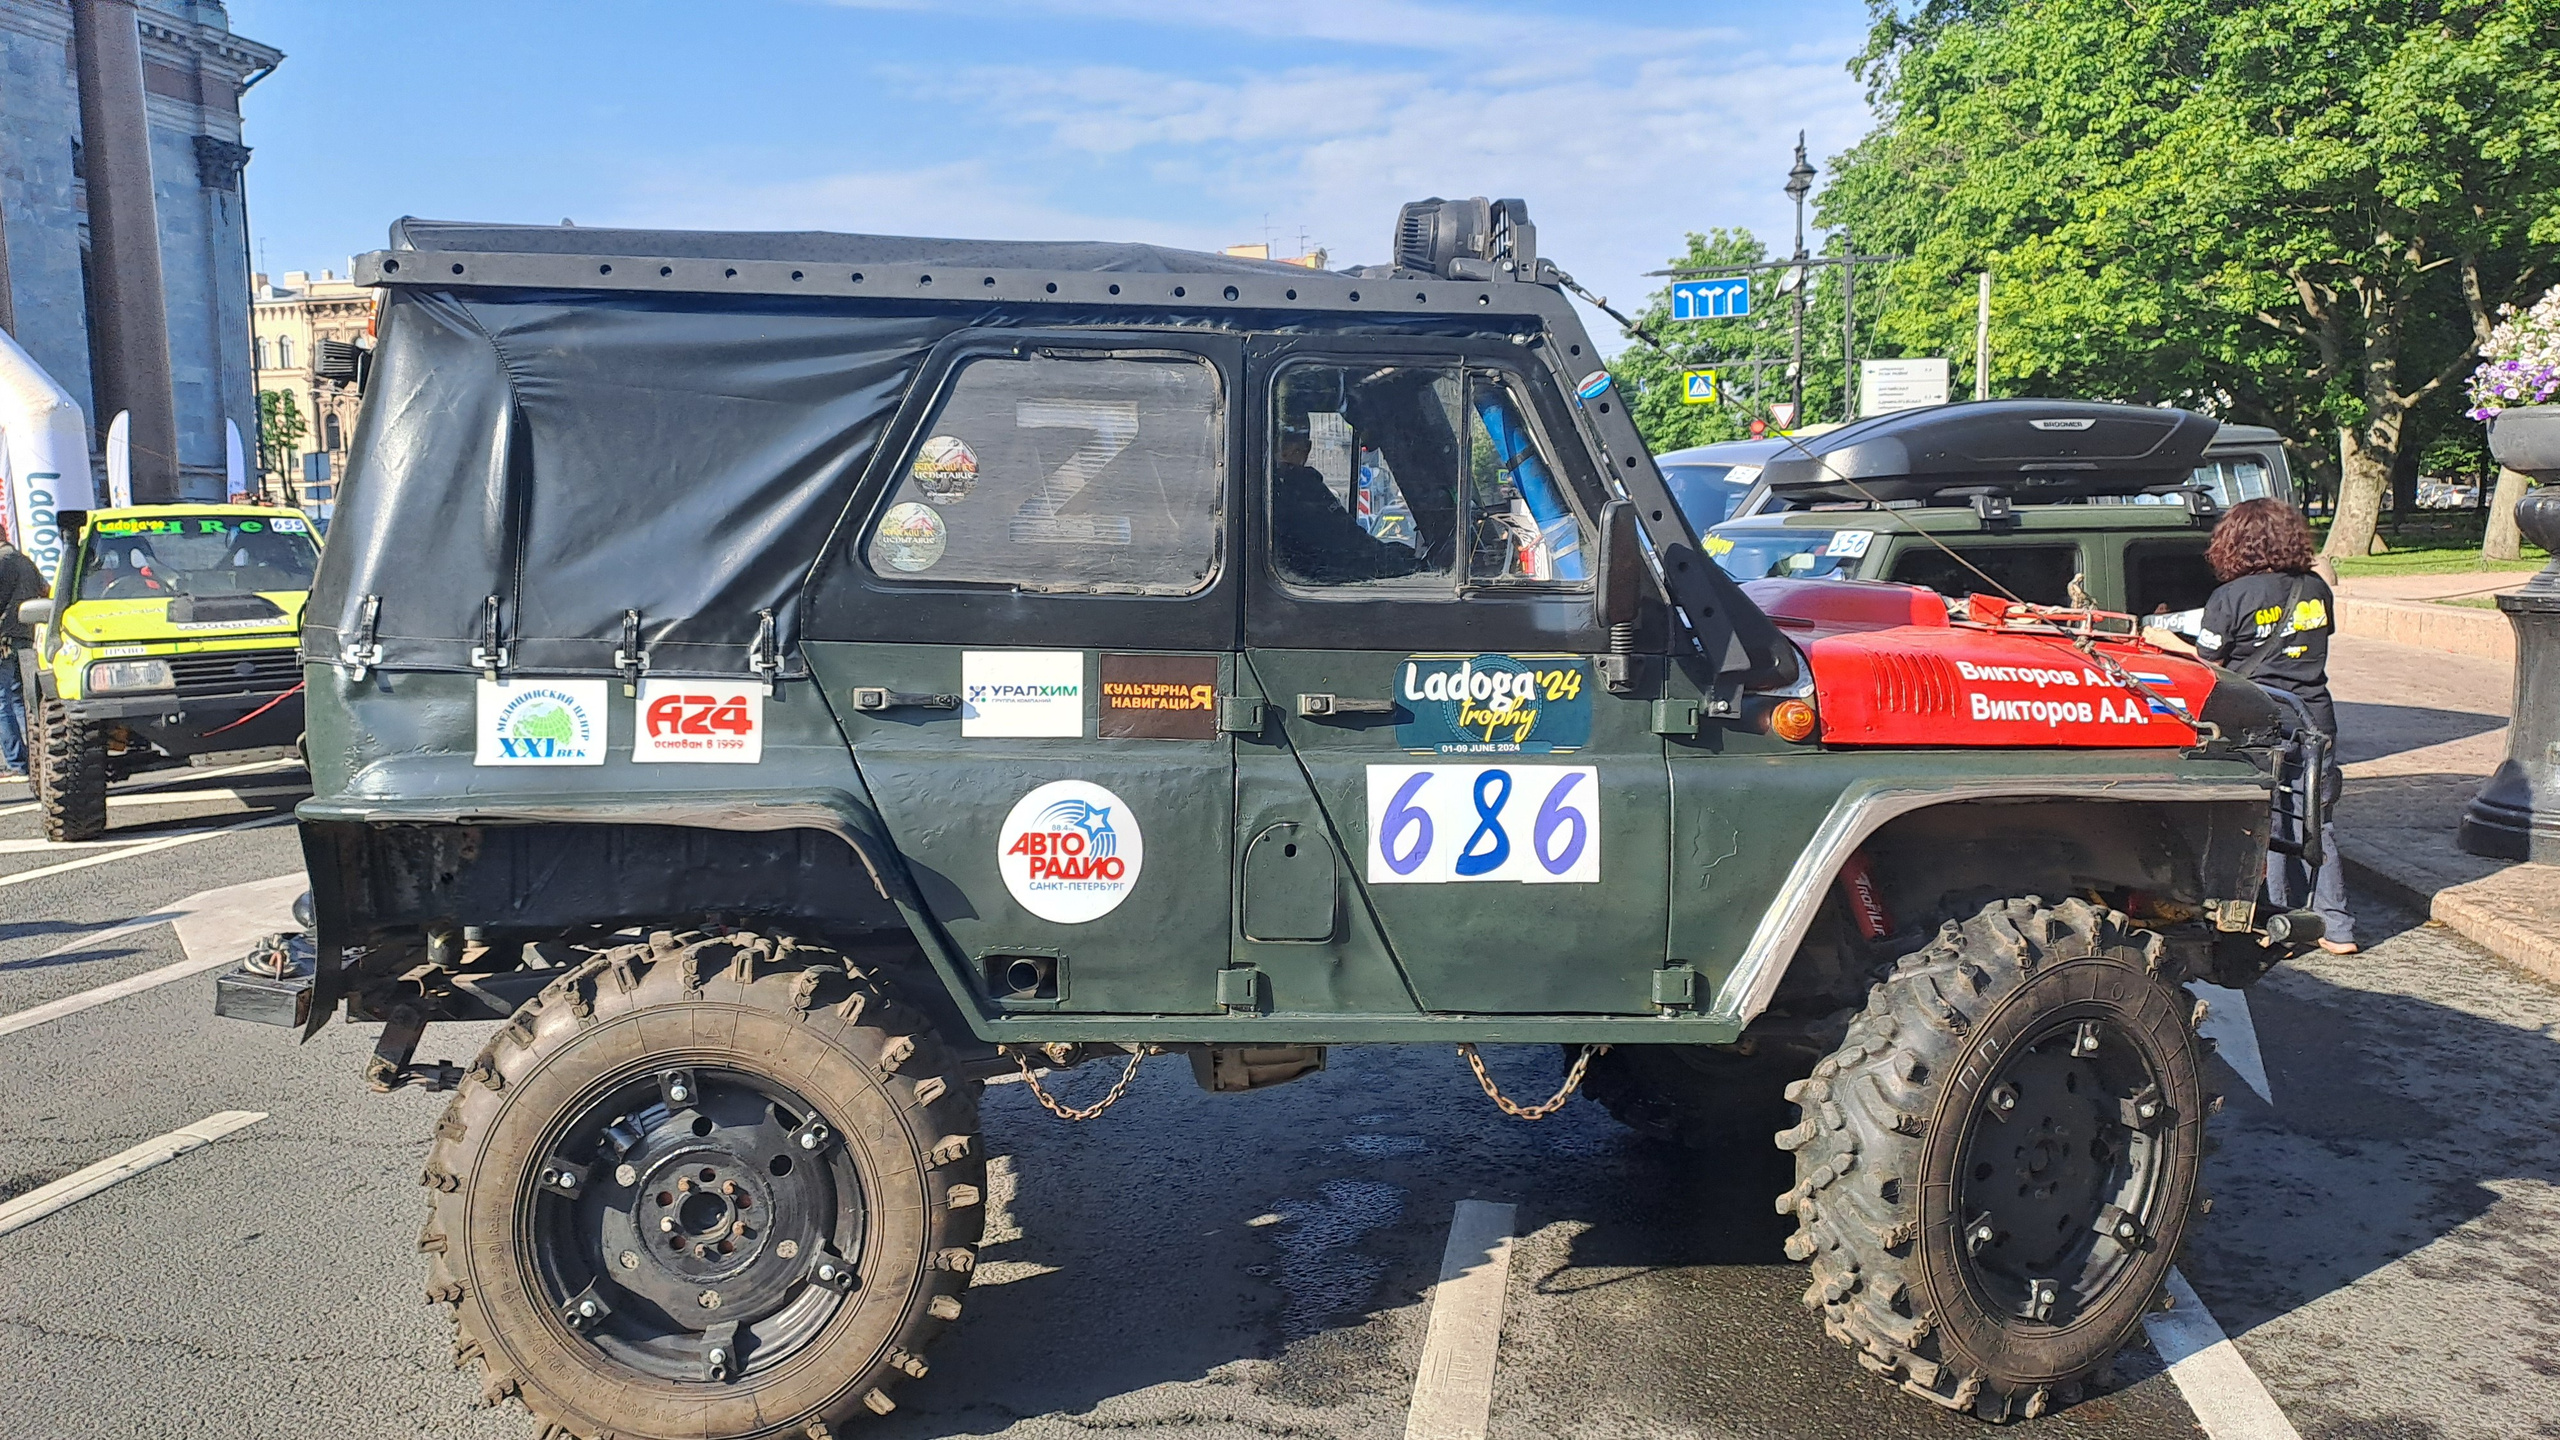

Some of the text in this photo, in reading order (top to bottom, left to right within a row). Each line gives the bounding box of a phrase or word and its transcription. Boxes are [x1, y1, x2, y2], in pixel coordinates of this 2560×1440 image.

[1955, 660, 2080, 688] Викторов
[991, 685, 1077, 697] УРАЛХИМ
[497, 689, 590, 741] МЕДИЦИНСКИЙ ЦЕНТР
[1970, 693, 2149, 728] Викторов А.А.
[497, 737, 555, 757] XXI
[654, 739, 702, 749] основан
[717, 739, 744, 749] 1999
[1441, 745, 1469, 753] 01-09
[1498, 744, 1521, 752] 2024
[1379, 768, 1587, 877] 686
[1007, 832, 1085, 856] АВТО
[1029, 856, 1125, 880] РАДИО
[1029, 881, 1125, 891] САНКТ-ПЕТЕРБУРГ
